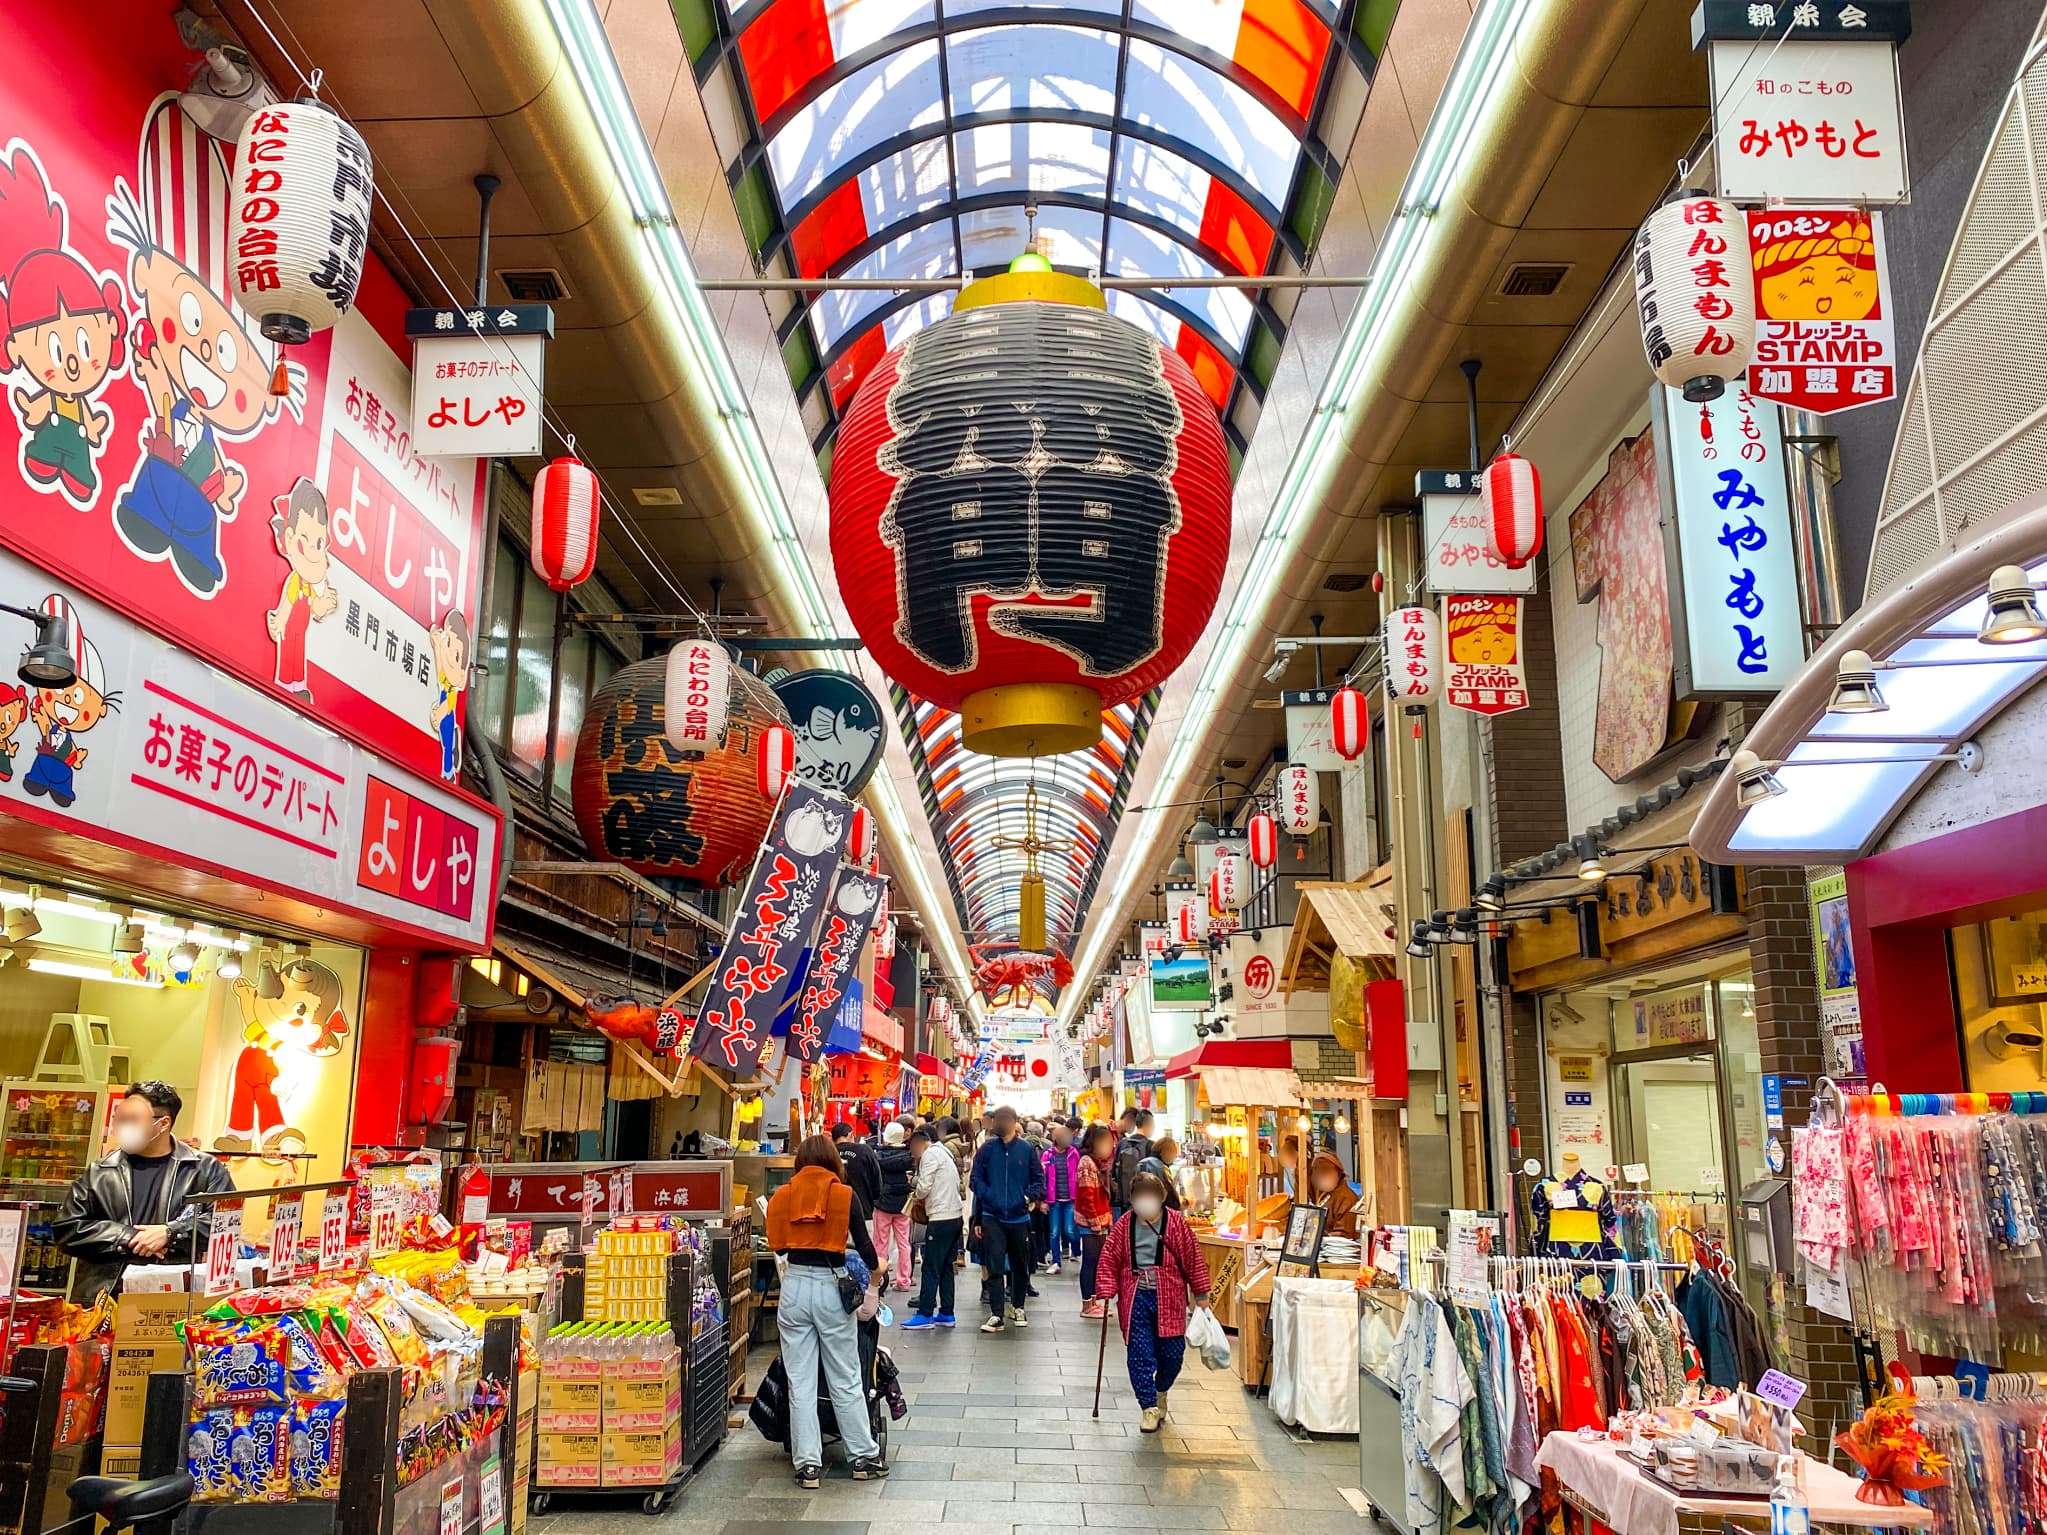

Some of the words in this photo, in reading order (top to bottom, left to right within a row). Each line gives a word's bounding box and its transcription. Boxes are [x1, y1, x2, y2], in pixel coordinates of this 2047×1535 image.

[1755, 79, 1853, 96] 和のこもの
[1739, 118, 1881, 158] みやもと
[237, 111, 290, 293] なにわの台所
[1752, 215, 1831, 244] クロモン
[1682, 201, 1735, 356] ほんまもん
[1766, 320, 1868, 341] フレッシュ
[1757, 340, 1883, 363] STAMP
[435, 360, 519, 379] お菓子のデパート
[1758, 367, 1885, 395] 加盟店
[427, 395, 526, 429] よしや
[1737, 388, 1767, 463] きもの
[333, 465, 455, 622] よしや
[1440, 542, 1500, 569] みやも
[1712, 468, 1769, 674] みやもと
[1449, 598, 1494, 614] クロモン
[345, 598, 432, 688] 黒門市場店
[1403, 610, 1430, 696] ほんまもん
[1451, 674, 1519, 690] STAMP
[1456, 664, 1511, 676] フレッシュ
[683, 645, 711, 741] なにわの台所
[1454, 690, 1522, 705] 加盟店
[142, 711, 339, 837] お菓子のデパート
[796, 755, 852, 786] っちり
[1292, 769, 1310, 828] ほんまもん
[366, 796, 473, 905] よしや
[1208, 921, 1240, 929] STAMP
[656, 1011, 679, 1049] 浜藤
[802, 1064, 847, 1079] Shi
